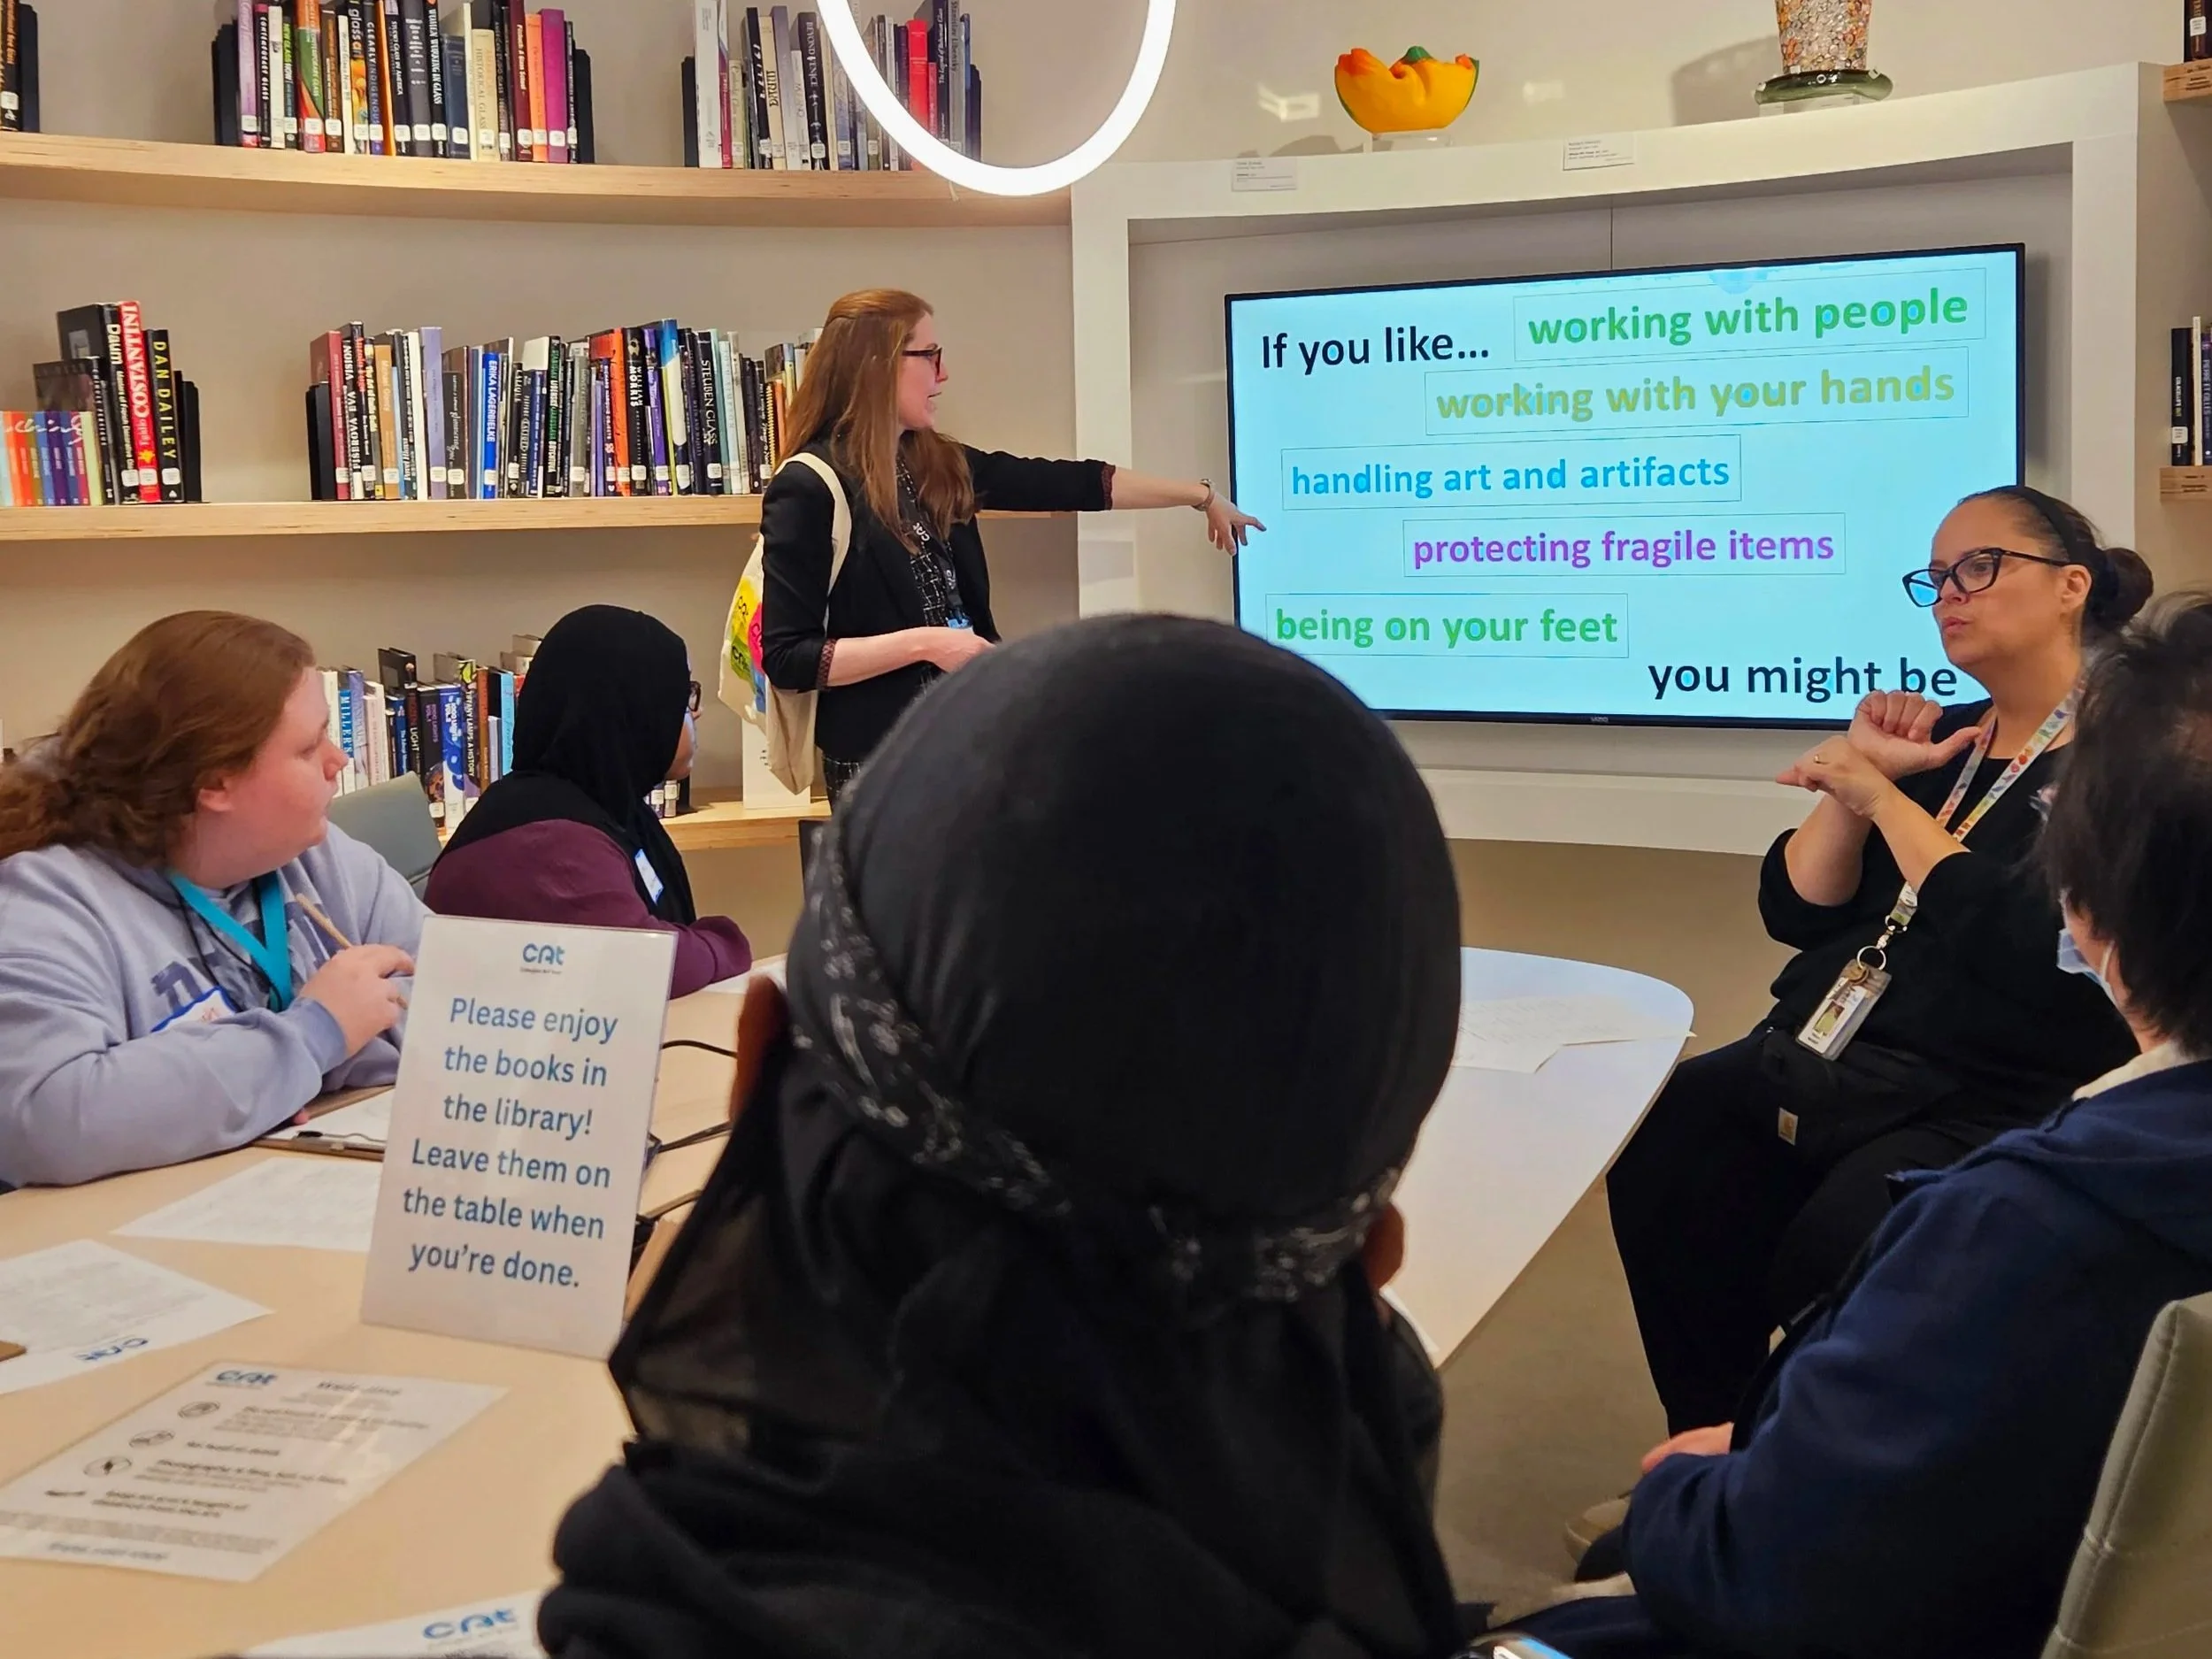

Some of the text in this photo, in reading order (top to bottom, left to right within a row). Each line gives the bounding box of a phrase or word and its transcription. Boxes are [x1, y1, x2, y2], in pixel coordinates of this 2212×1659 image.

[349, 9, 365, 40] glass
[367, 21, 378, 63] CLEARLY
[428, 9, 439, 37] WOMEN
[430, 39, 442, 73] WORKING
[434, 81, 443, 104] GLASS
[1528, 287, 1969, 346] working with people
[121, 304, 150, 418] COSTANTINI
[342, 340, 355, 380] VISION
[1262, 325, 1490, 375] If you like...
[153, 341, 177, 459] DAN DAILEY
[487, 359, 497, 442] ERIKA LAGERBIELKE
[629, 365, 638, 407] MORRIS
[701, 359, 718, 445] STEUBEN GLASS
[1436, 365, 1955, 423] working with your hands
[1292, 456, 1731, 499] handling art and artifacts
[1414, 528, 1835, 571] protecting fragile items
[1276, 608, 1618, 649] being on your feet
[1647, 656, 1958, 703] you might be
[410, 726, 420, 752] LIGHT
[449, 997, 618, 1045] Please enjoy
[444, 1045, 608, 1087] the books in
[443, 1094, 593, 1141] the library!
[411, 1138, 611, 1188] Leave them on
[403, 1187, 604, 1240] the table when
[503, 1250, 580, 1288] done.
